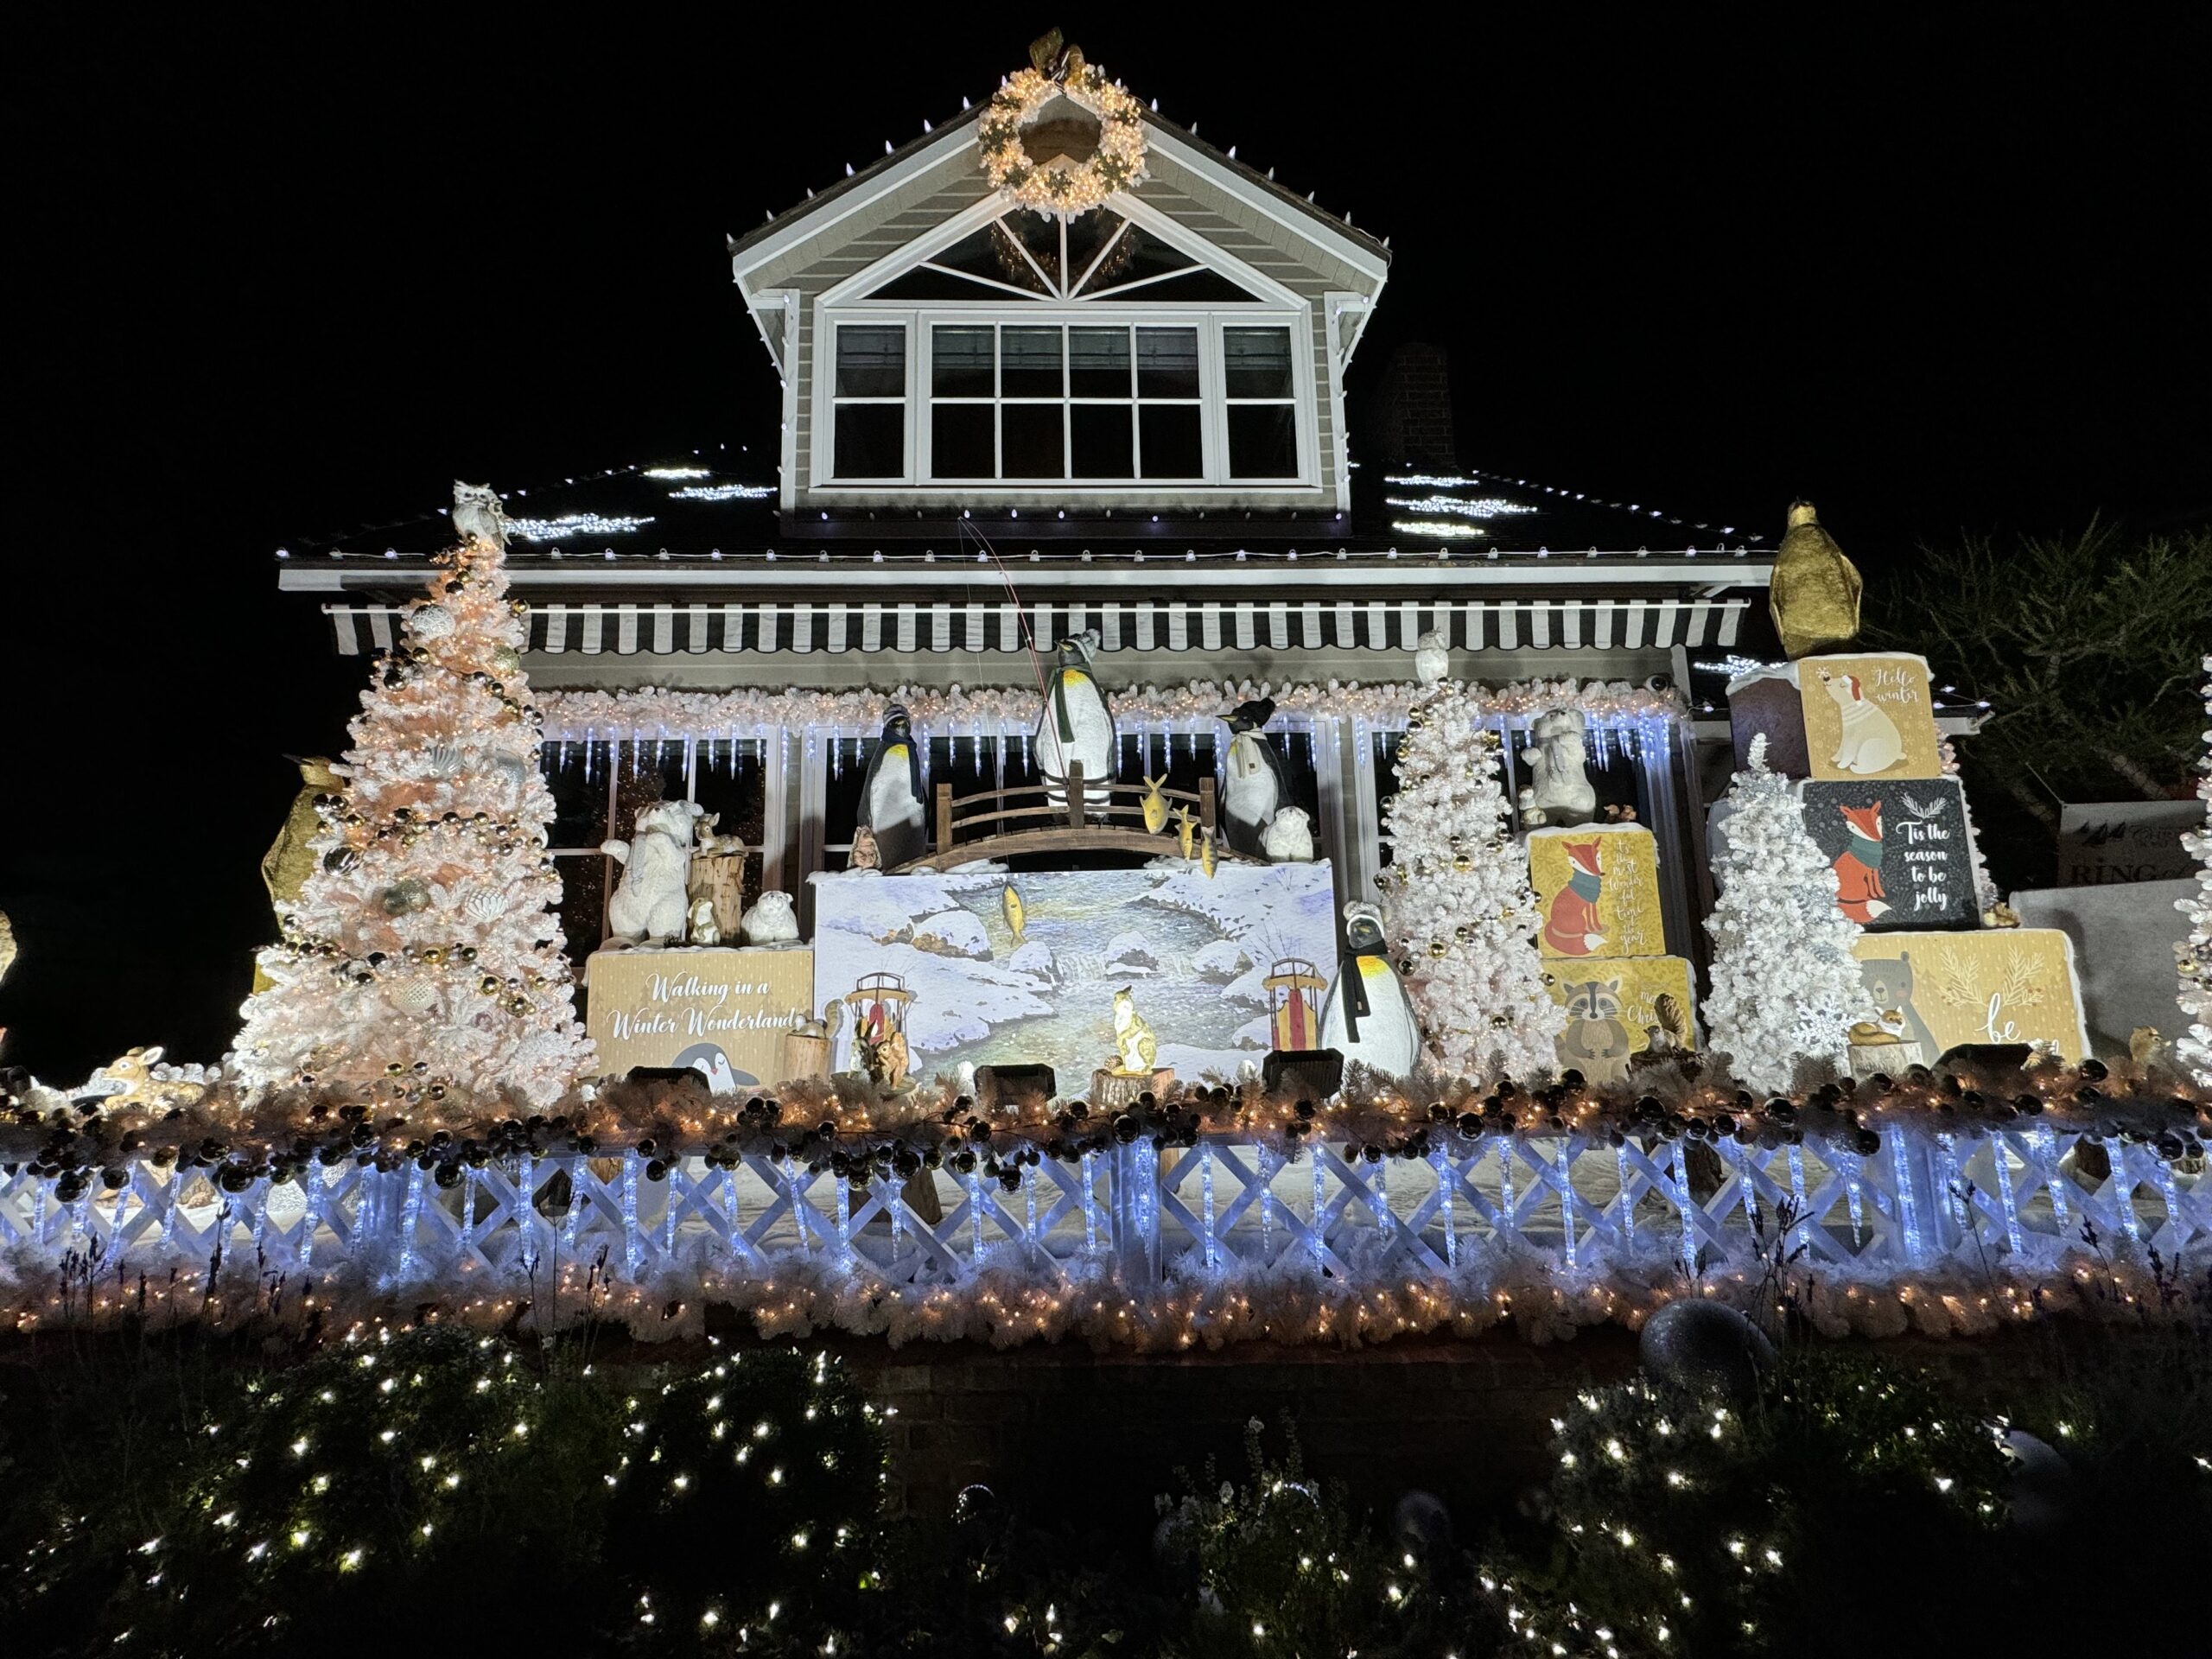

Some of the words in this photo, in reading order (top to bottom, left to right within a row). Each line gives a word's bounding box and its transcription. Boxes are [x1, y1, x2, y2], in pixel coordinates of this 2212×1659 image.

[1873, 666, 1916, 687] Hello
[1875, 687, 1918, 703] winter
[1928, 823, 1950, 840] the
[1904, 850, 1948, 862] season
[1911, 866, 1926, 882] to
[1929, 866, 1946, 882] be
[1613, 899, 1645, 920] time
[1914, 887, 1948, 911] jolly
[1620, 930, 1647, 955] year
[645, 969, 730, 1004] Walking
[734, 980, 753, 995] in
[757, 983, 771, 995] a
[607, 1007, 677, 1040] Winter
[682, 1005, 796, 1037] Wonderland
[1974, 993, 2021, 1043] be
